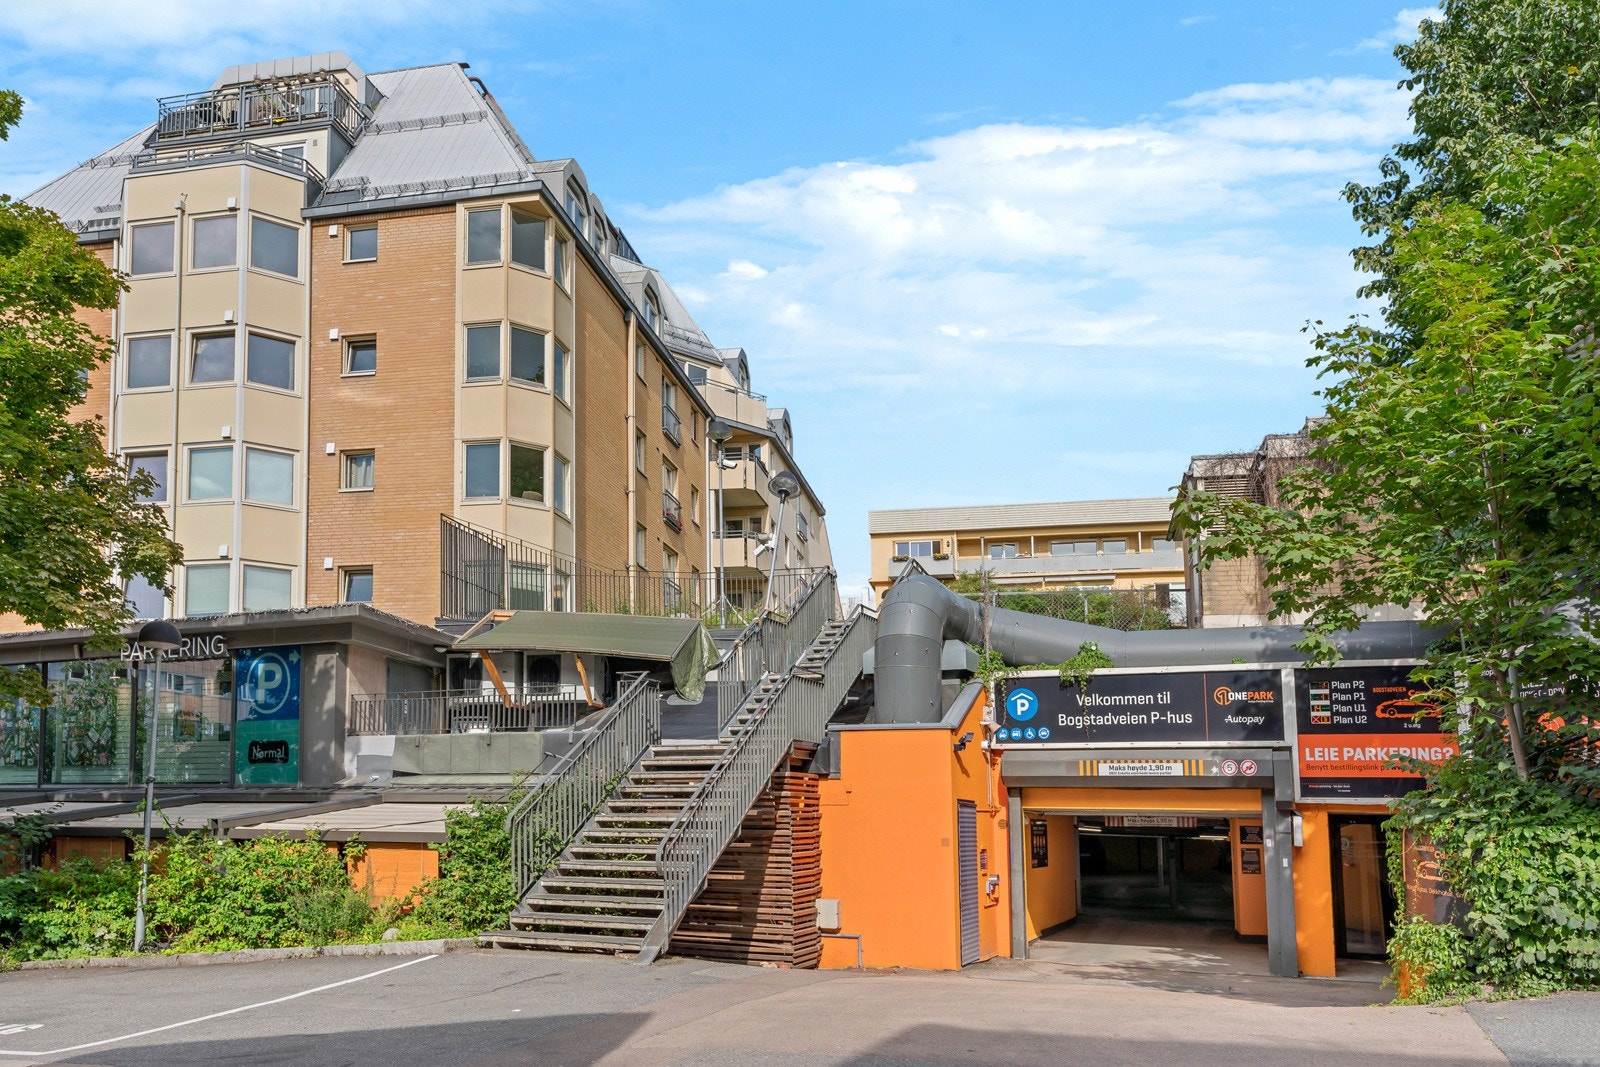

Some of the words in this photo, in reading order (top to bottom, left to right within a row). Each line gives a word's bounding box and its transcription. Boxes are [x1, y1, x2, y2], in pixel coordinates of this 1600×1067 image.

[120, 634, 225, 661] PARRING
[257, 662, 283, 704] P
[1331, 681, 1351, 689] Plan
[1352, 680, 1365, 689] P2
[1075, 693, 1154, 707] Velkommen
[1157, 691, 1171, 704] til
[1332, 693, 1351, 701] Plan
[1353, 692, 1366, 701] P1
[1016, 698, 1030, 716] P
[1333, 704, 1352, 713] Plan
[1353, 703, 1367, 712] U1
[1058, 712, 1147, 728] Bogstadveien
[1150, 711, 1193, 724] P-hus
[1224, 714, 1265, 725] Autopay
[1333, 716, 1352, 724] Plan
[1353, 715, 1368, 724] U2
[1305, 747, 1339, 761] LEIE
[1127, 764, 1147, 772] høyde
[1148, 764, 1164, 772] 1,90
[1306, 763, 1328, 771] Benytt
[1330, 763, 1379, 771] bestillingslink
